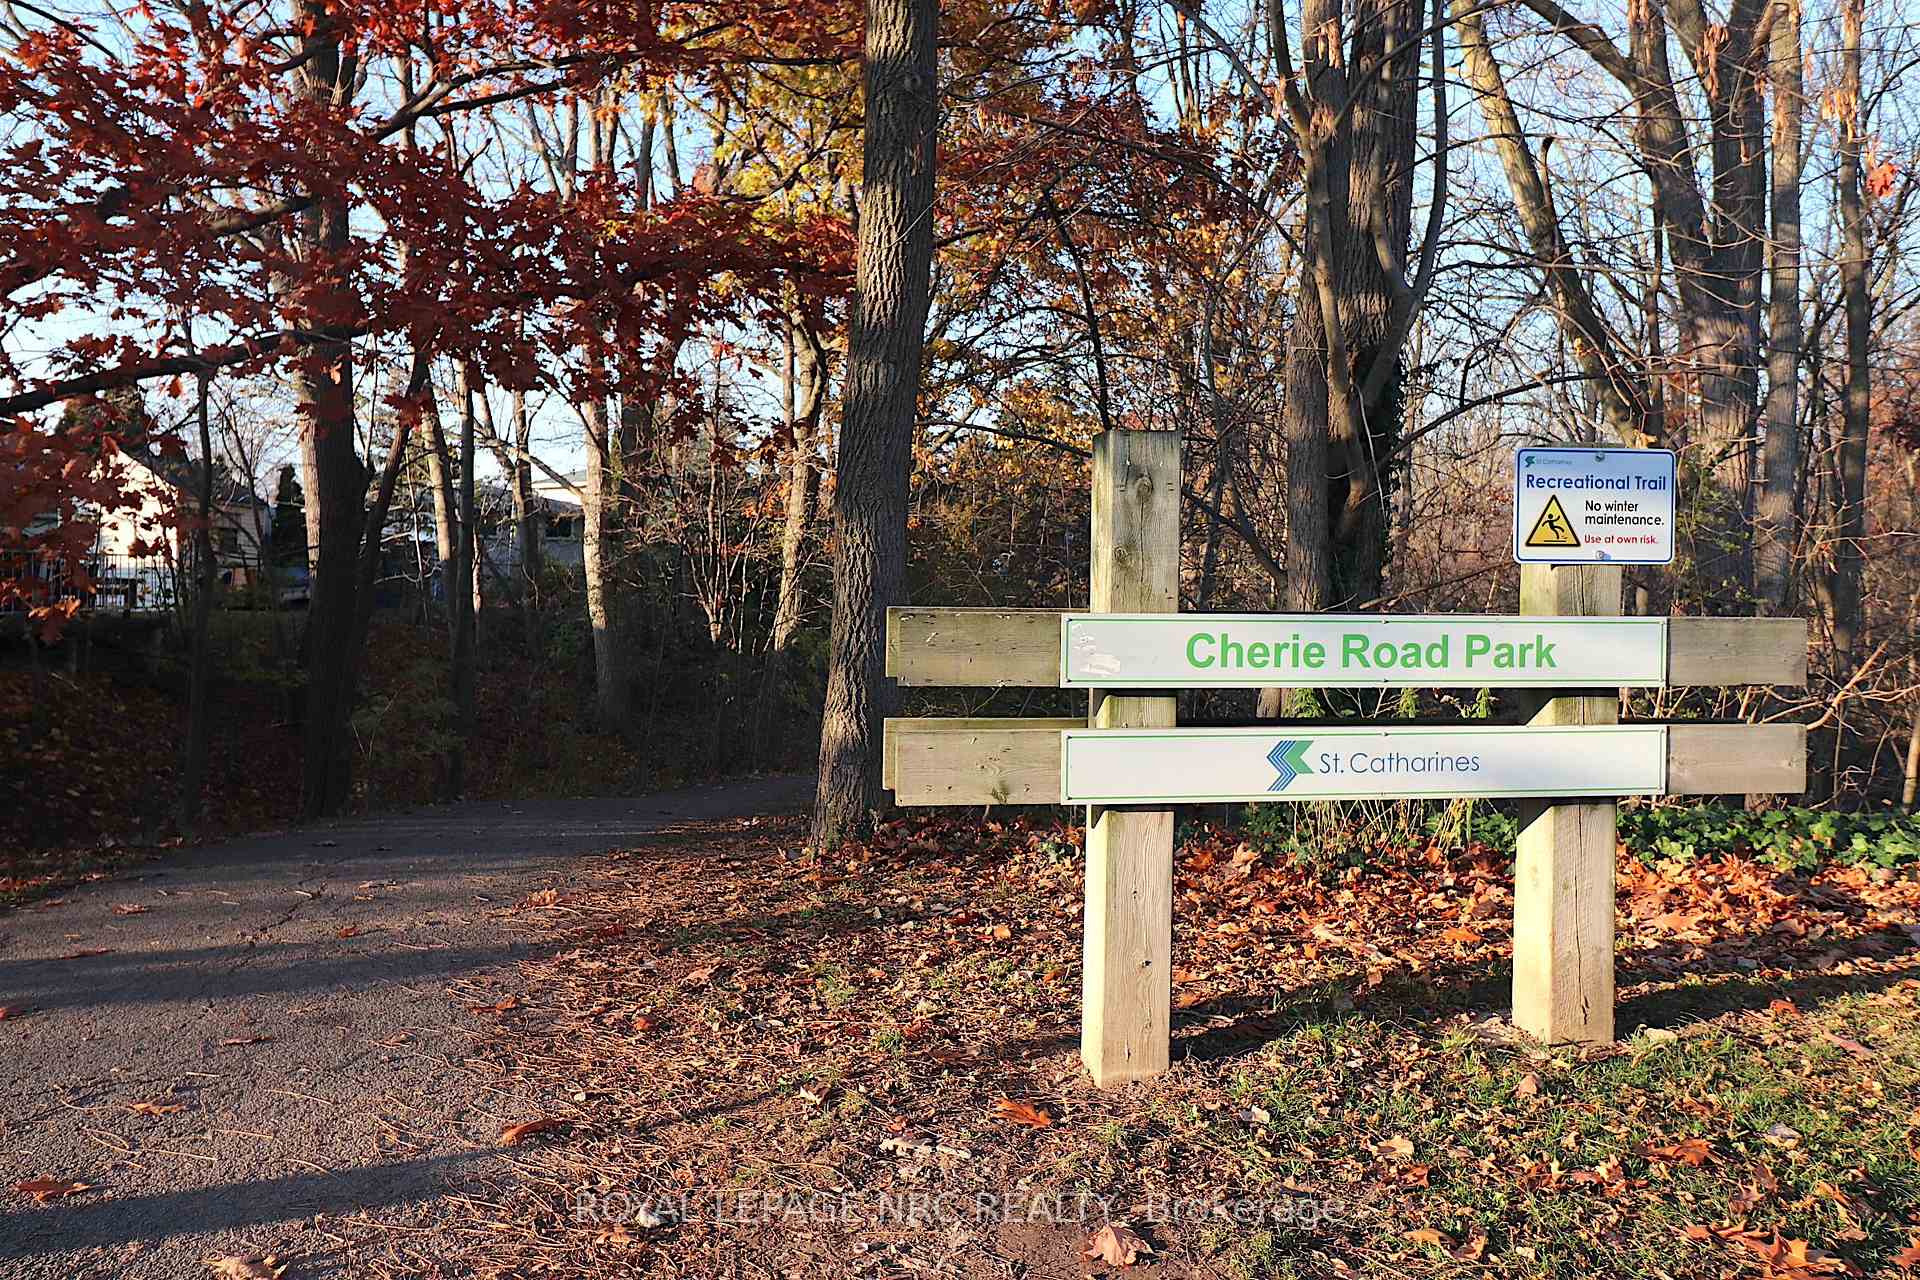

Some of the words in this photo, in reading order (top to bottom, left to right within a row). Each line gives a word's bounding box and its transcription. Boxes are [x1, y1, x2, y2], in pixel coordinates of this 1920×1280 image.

[1526, 474, 1630, 490] Recreational
[1634, 476, 1666, 490] Trail
[1585, 500, 1601, 512] No
[1605, 501, 1639, 512] winter
[1585, 513, 1664, 526] maintenance.
[1584, 535, 1601, 544] Use
[1604, 535, 1614, 544] at
[1640, 535, 1659, 544] risk.
[1185, 633, 1326, 669] Cherie
[1342, 634, 1449, 669] Road
[1465, 634, 1556, 669] Park
[1319, 752, 1344, 774] St.
[1350, 752, 1480, 773] Catharines
